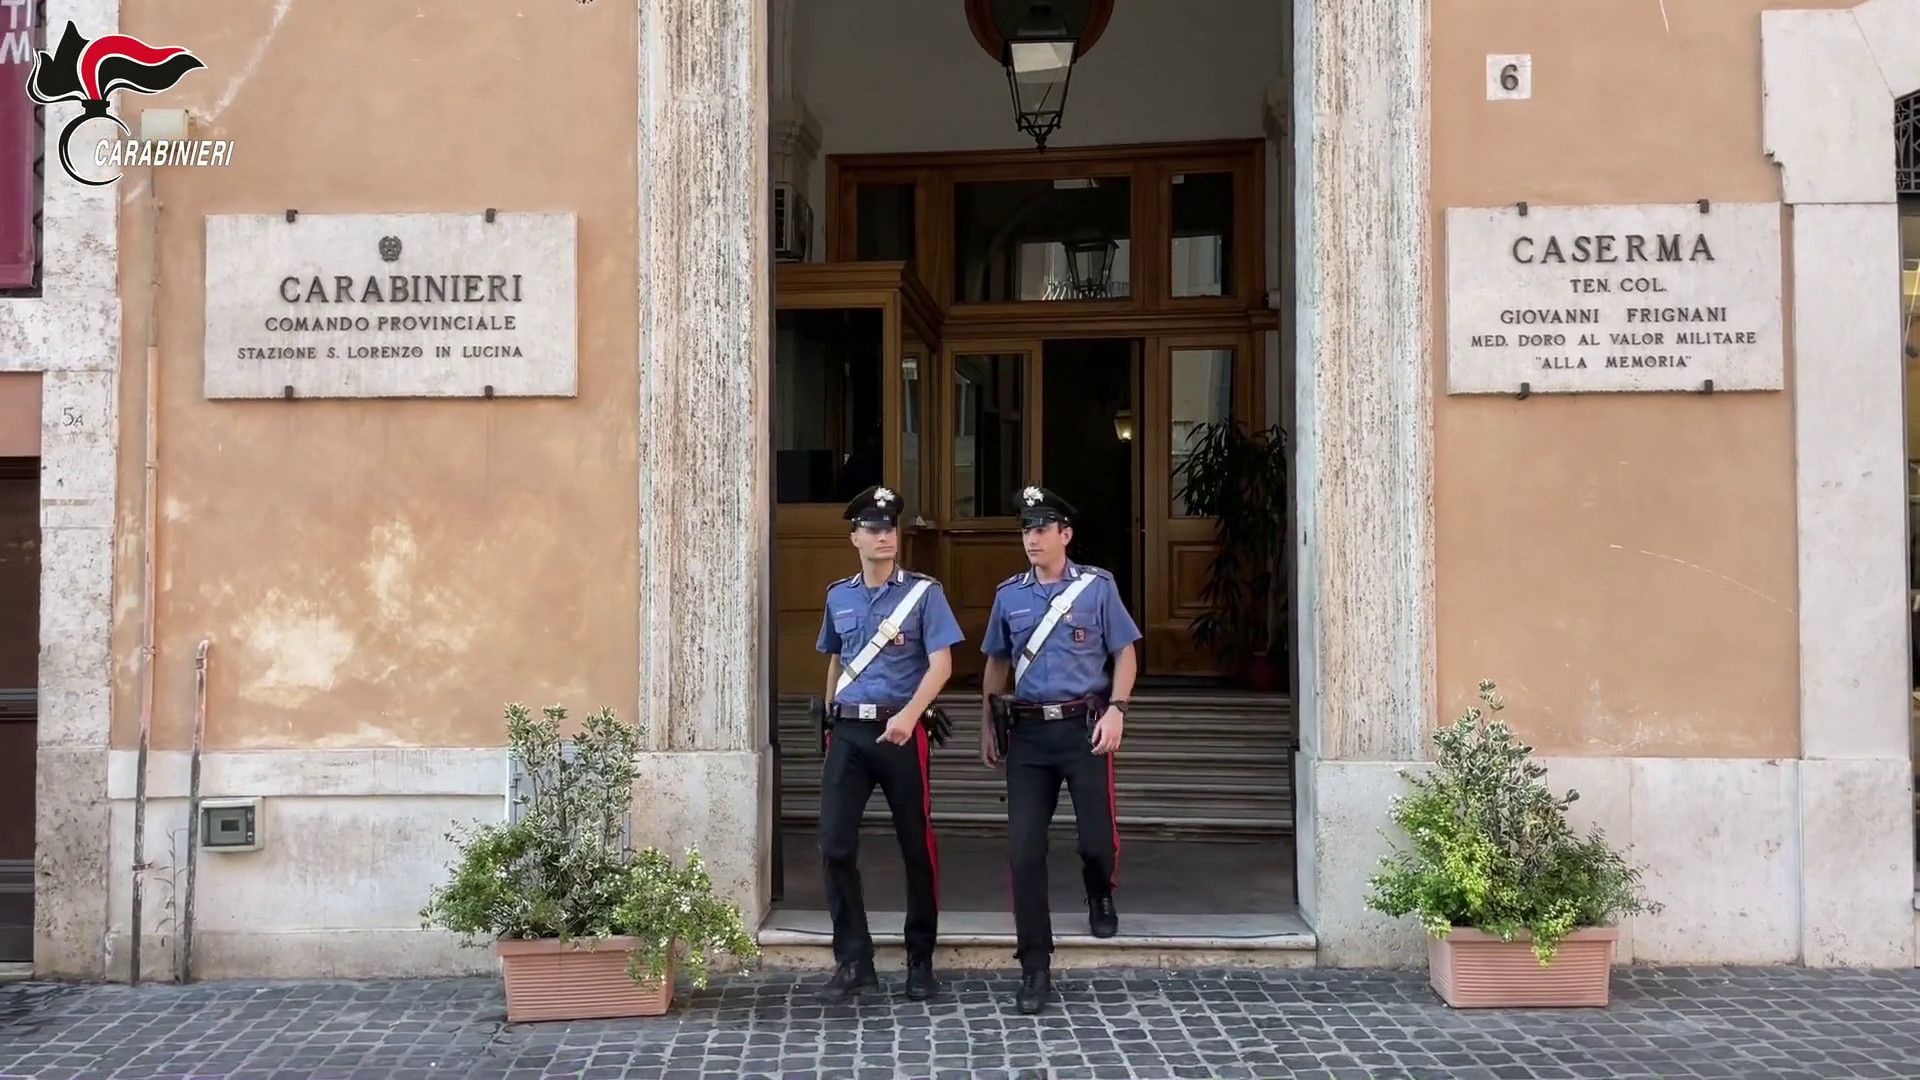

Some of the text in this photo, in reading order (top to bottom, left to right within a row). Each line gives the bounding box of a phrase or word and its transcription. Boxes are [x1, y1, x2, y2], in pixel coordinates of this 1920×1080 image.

[1500, 64, 1519, 91] 6
[1512, 234, 1715, 264] CASERMA
[280, 274, 523, 303] CARABINIERI
[1570, 278, 1667, 293] TEN. COL.
[265, 315, 517, 331] COMANDO PROVINCIALE
[1500, 307, 1727, 324] GIOVANNI FRIGNANI
[1471, 335, 1508, 347] MED.
[1578, 333, 1600, 346] AL
[1609, 333, 1664, 345] VALOR
[1676, 332, 1757, 345] MILITARE
[237, 345, 523, 359] STAZIONE S. LORENZO IN LUCINA
